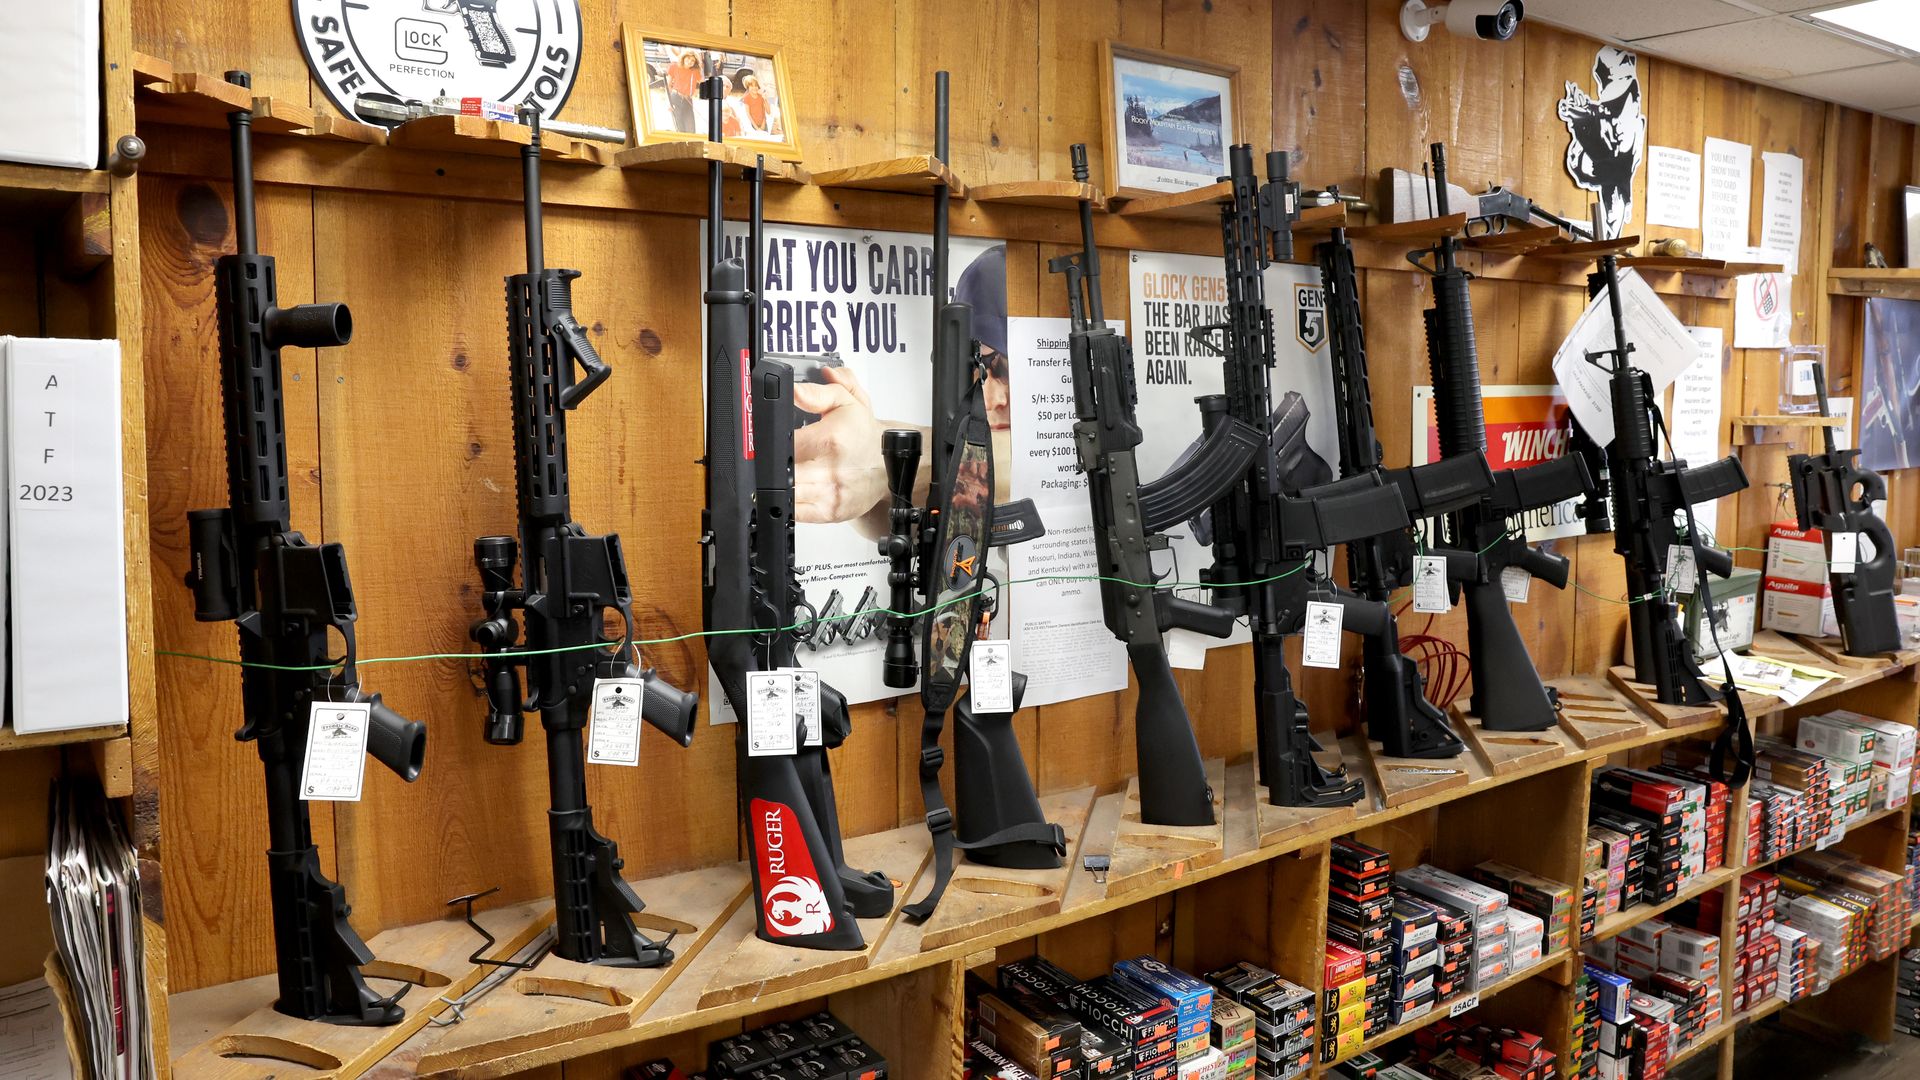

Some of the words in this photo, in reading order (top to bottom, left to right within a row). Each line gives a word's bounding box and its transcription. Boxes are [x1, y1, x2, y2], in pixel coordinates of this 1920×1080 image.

[389, 63, 455, 79] PERFECTION
[521, 45, 569, 113] TOLS
[1131, 115, 1148, 125] ROCKY
[1150, 118, 1176, 129] MOUNTAIN
[1186, 124, 1217, 136] FOUNDATION
[806, 240, 857, 294] YOU
[868, 243, 955, 298] CARR,
[1143, 272, 1188, 300] GLOCK
[1191, 276, 1225, 302] GEN5
[1298, 289, 1323, 307] GEN
[1144, 301, 1170, 328] THE
[1174, 303, 1200, 328] BAR
[1205, 305, 1230, 327] HAS
[763, 300, 836, 353] RRIES
[847, 301, 906, 353] YOU.
[1145, 330, 1179, 356] BEEN
[1185, 331, 1226, 357] RAISE
[1028, 358, 1061, 367] Transfer
[1062, 358, 1071, 367] Fe
[1146, 359, 1192, 384] AGAIN.
[1061, 375, 1072, 384] Gu
[744, 357, 755, 451] RUGER
[1032, 394, 1049, 404] S/H:
[1051, 393, 1063, 404] $35
[1037, 411, 1052, 421] $50
[1054, 413, 1067, 421] per
[1068, 411, 1079, 420] Lo
[1029, 449, 1050, 459] every
[1052, 447, 1071, 457] $100
[1502, 428, 1569, 464] WINCH
[20, 484, 73, 502] 2023
[1048, 526, 1086, 536] Non-resident
[1774, 527, 1806, 538] Aguila
[1032, 540, 1070, 550] surrounding
[815, 563, 833, 571] PLUS,
[1028, 567, 1040, 576] and
[1040, 565, 1072, 576] Kentucky)
[1072, 563, 1086, 571] with
[1036, 580, 1047, 588] can
[1061, 588, 1082, 596] ammo.
[1767, 580, 1799, 591] Aguila
[765, 808, 786, 875] RUGER
[806, 901, 821, 914] R
[1006, 963, 1057, 996] FIOCCHI
[1073, 984, 1131, 1017] FIOCCHI
[1453, 997, 1477, 1014] 45ACP
[1081, 1001, 1133, 1039] FIOCCHI
[969, 1040, 1005, 1066] AMERICAN
[1001, 1059, 1032, 1080] EAGLE
